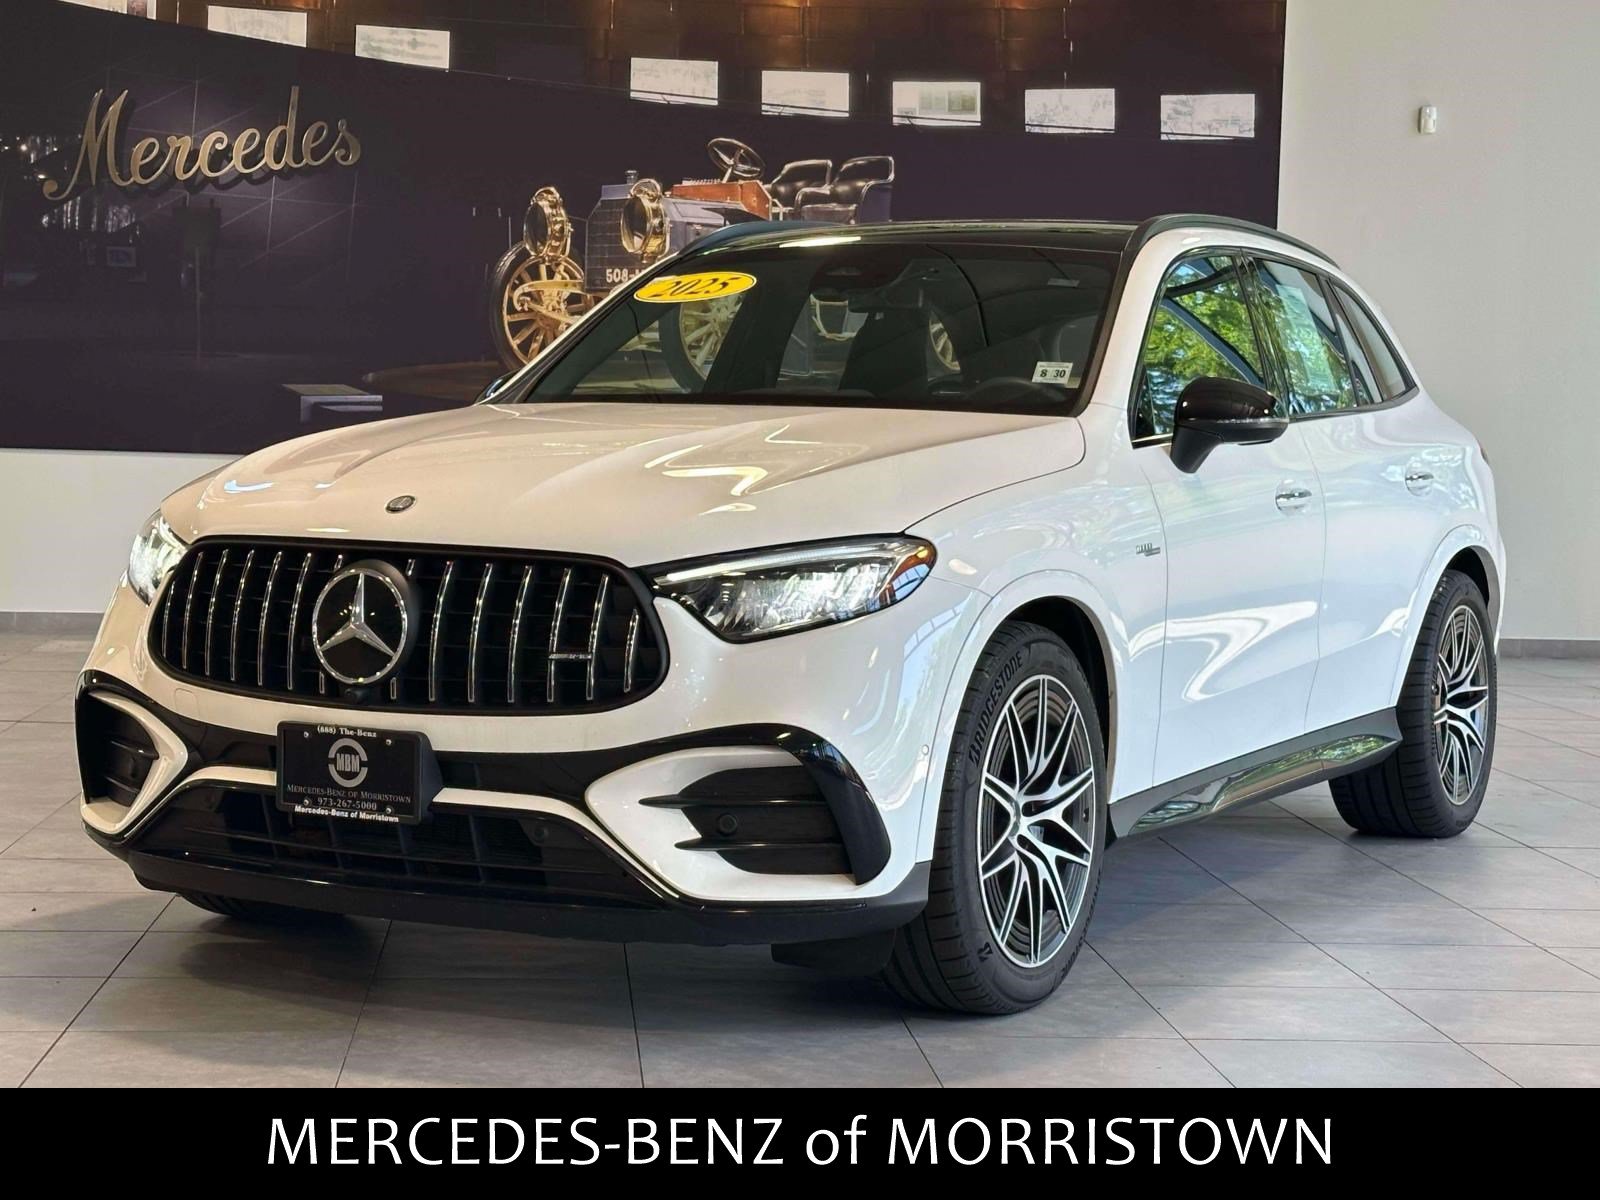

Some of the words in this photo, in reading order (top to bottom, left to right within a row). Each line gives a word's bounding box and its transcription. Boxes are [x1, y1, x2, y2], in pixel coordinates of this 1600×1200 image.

[43, 86, 361, 200] Mercedes
[647, 277, 742, 298] 2025
[1053, 369, 1067, 378] 30
[968, 650, 1024, 768] BRIDGESTONE
[339, 728, 377, 738] The-Benz
[336, 753, 360, 773] MBM
[287, 784, 346, 797] MERCEDES-BENZ
[360, 791, 412, 804] MORRISTOWN
[317, 797, 377, 811] 973-267-5000
[294, 805, 348, 818] Mercedes-Benz
[359, 811, 399, 823] Morristown
